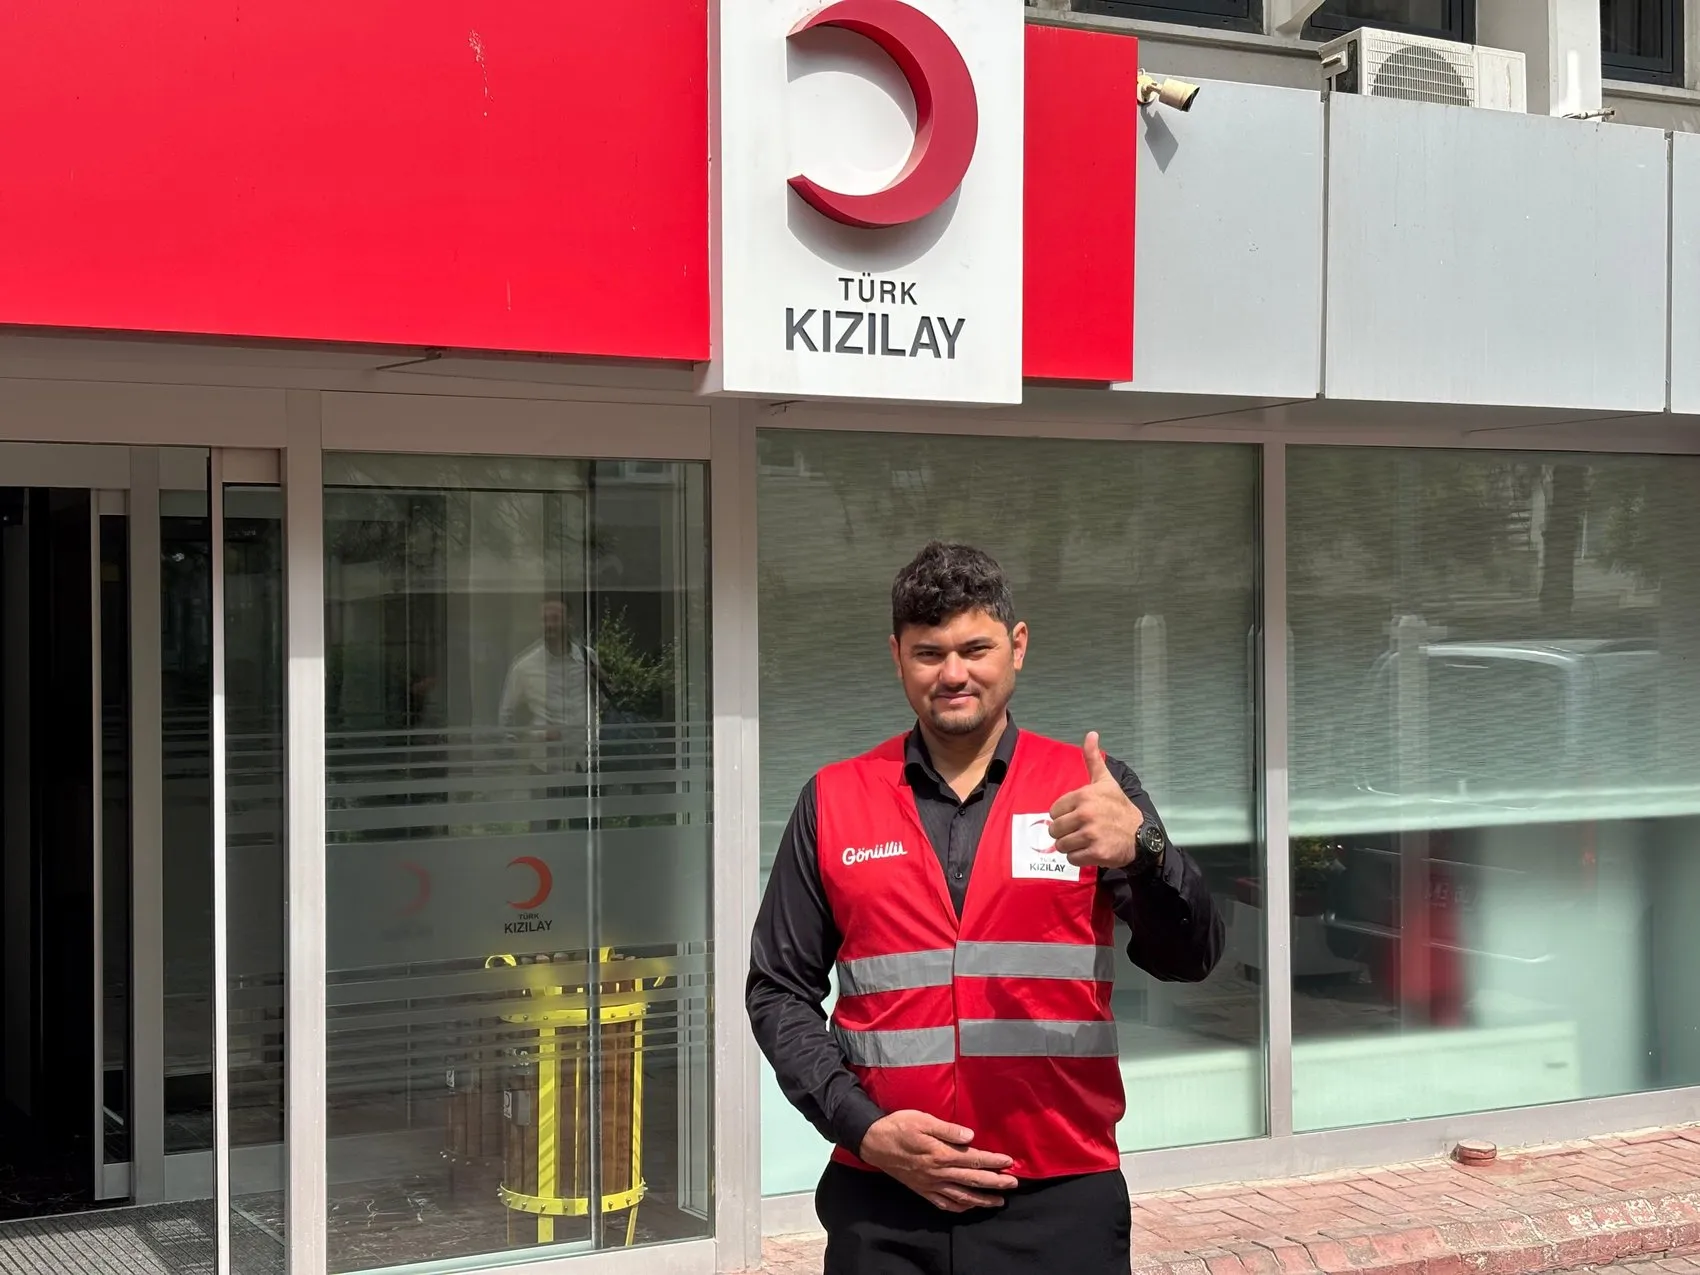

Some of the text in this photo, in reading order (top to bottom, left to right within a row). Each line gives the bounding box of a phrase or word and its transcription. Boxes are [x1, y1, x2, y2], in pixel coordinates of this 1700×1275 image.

[838, 272, 918, 305] TÜRK
[785, 307, 966, 359] KIZILAY
[842, 841, 908, 866] Gönüllü
[1029, 863, 1066, 872] KIZILAY
[519, 912, 540, 920] TÜRK
[504, 920, 553, 934] KIZILAY
